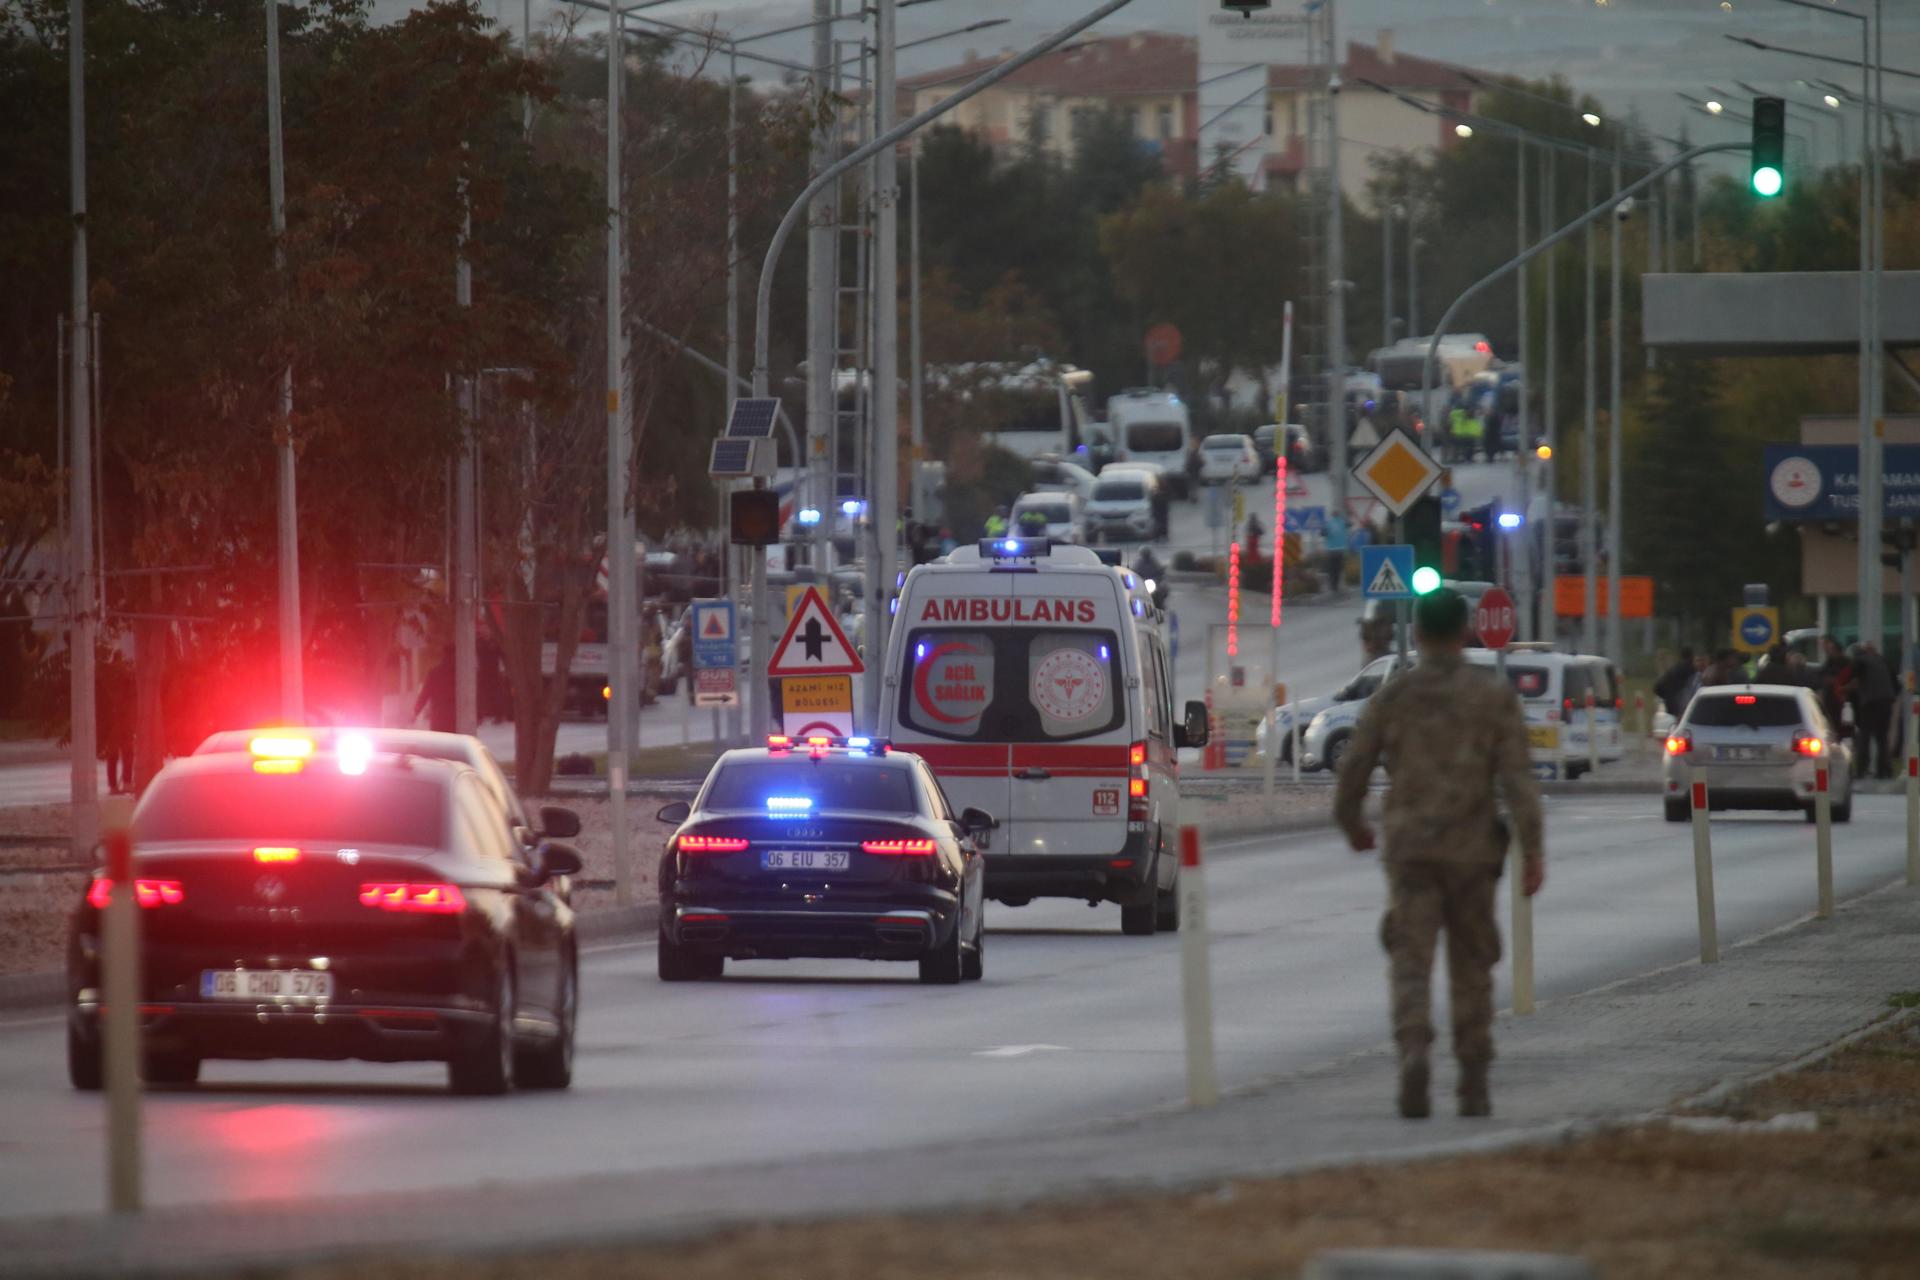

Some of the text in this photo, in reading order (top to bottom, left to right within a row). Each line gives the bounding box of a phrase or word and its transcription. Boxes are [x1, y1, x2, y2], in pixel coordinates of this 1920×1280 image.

[921, 599, 1096, 623] AMBULANS
[1479, 606, 1512, 632] DUR
[1096, 791, 1115, 805] 112
[768, 852, 847, 867] 06 EIU 357
[215, 974, 236, 993] 06
